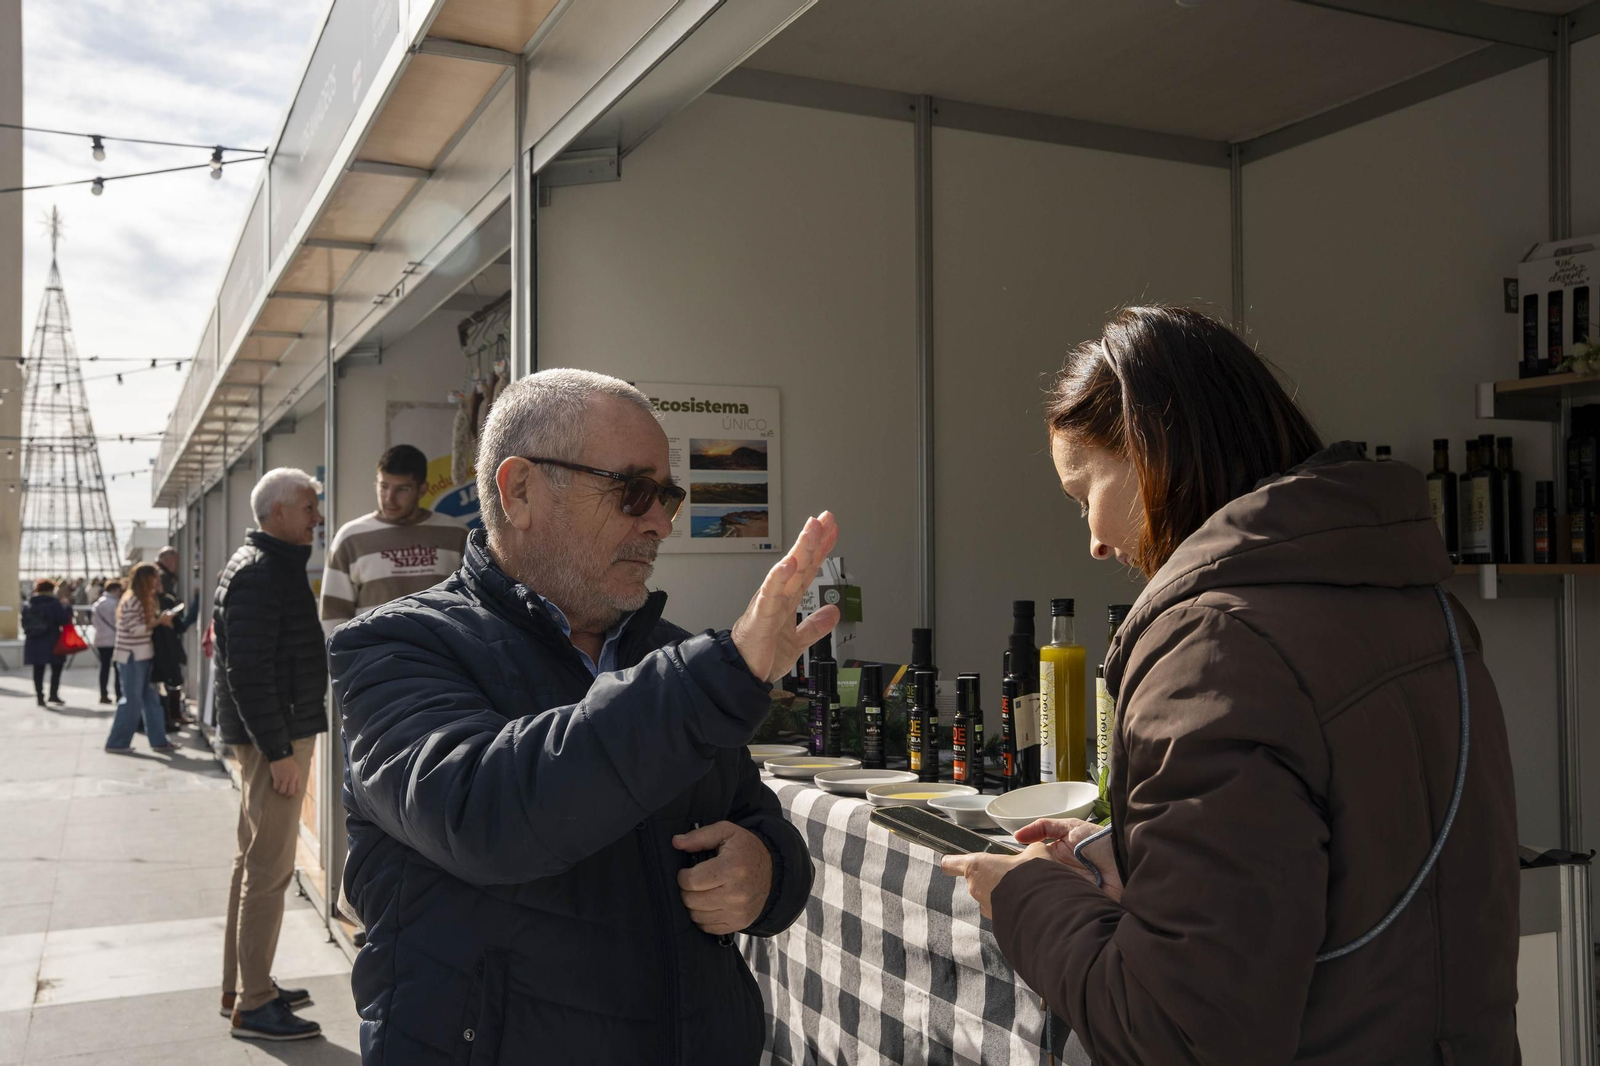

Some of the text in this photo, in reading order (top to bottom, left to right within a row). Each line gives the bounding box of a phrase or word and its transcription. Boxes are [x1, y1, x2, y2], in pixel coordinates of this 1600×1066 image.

[650, 397, 749, 415] Ecosistema
[722, 416, 768, 431] ÚNICO
[1100, 712, 1108, 769] DORADA
